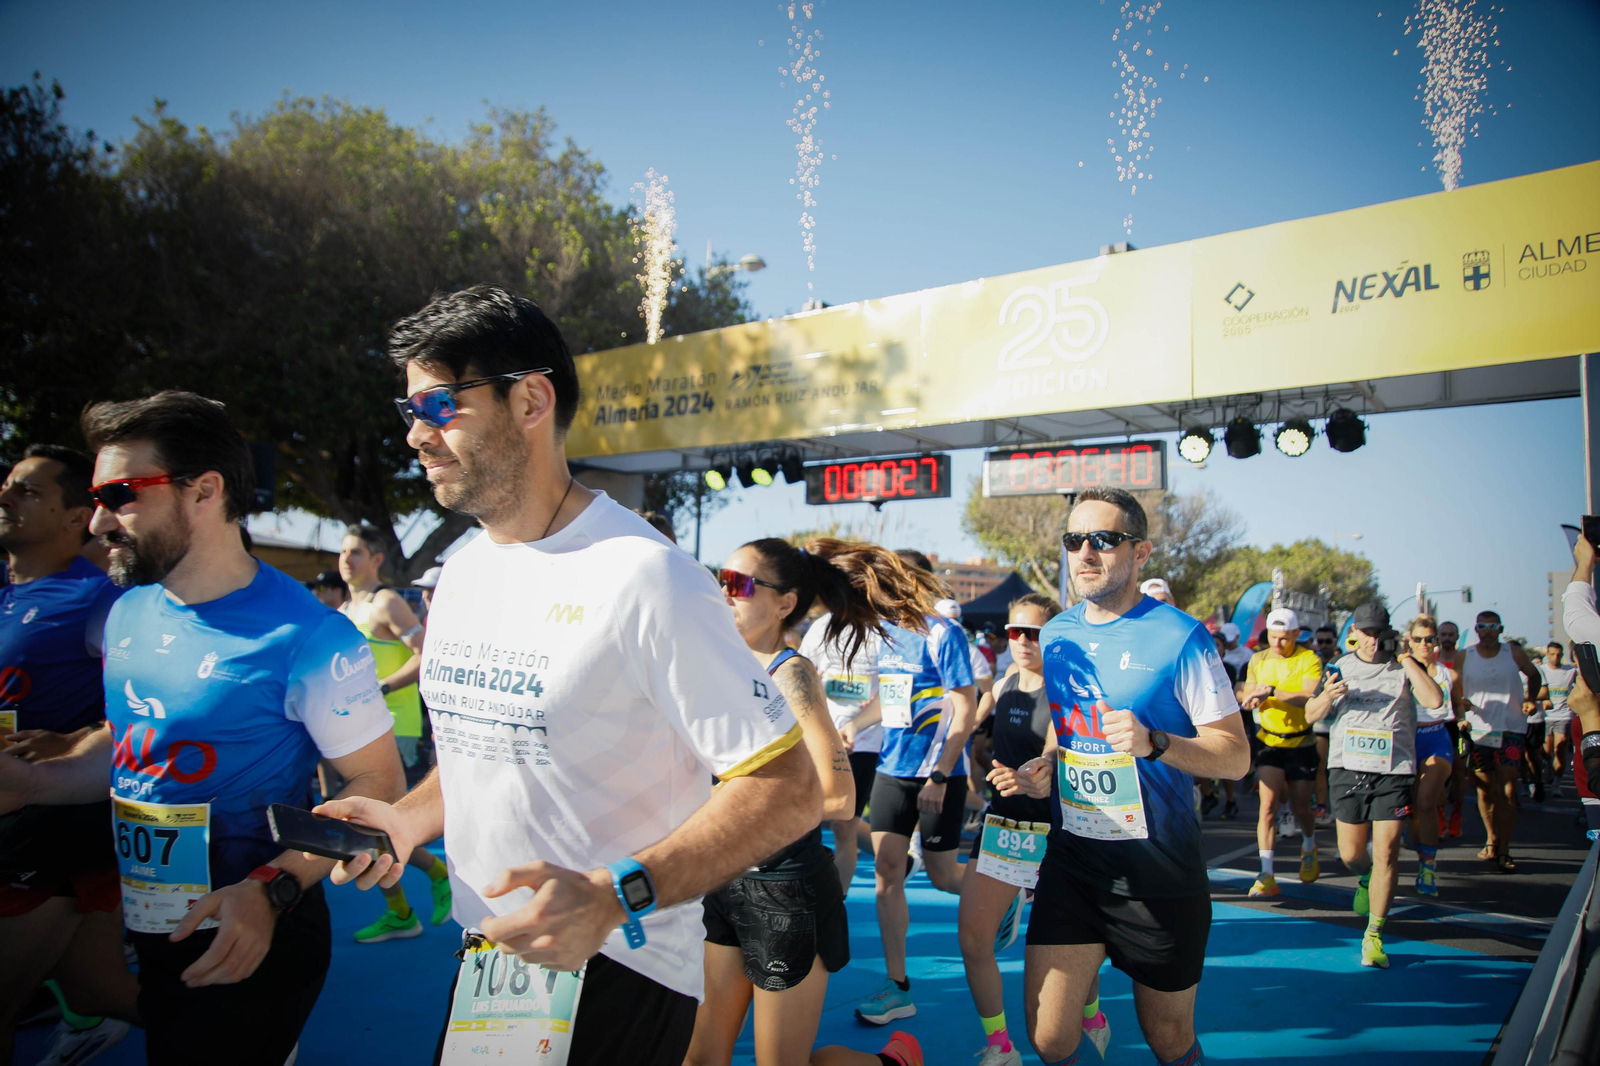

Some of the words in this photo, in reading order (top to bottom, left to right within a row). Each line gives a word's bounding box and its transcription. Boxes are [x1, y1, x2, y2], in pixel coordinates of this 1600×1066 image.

[1518, 231, 1600, 264] ALME
[1518, 259, 1587, 281] CIUDAD
[997, 272, 1110, 371] 25
[1223, 306, 1310, 327] COOPERACIÓN
[1223, 325, 1251, 337] 2005
[597, 380, 642, 400] Medio
[647, 371, 716, 395] Maratón
[776, 388, 806, 404] RUIZ
[594, 397, 660, 425] Almería
[663, 392, 715, 418] 2024
[478, 642, 549, 670] Maratón
[424, 658, 486, 689] Almería
[489, 667, 544, 698] 2024
[460, 696, 485, 711] RUIZ
[488, 701, 546, 721] ANDÚJAR
[1049, 702, 1108, 740] GAL
[106, 720, 217, 784] ALO
[1070, 740, 1107, 754] SPORT
[1349, 735, 1387, 751] 1670
[117, 776, 155, 796] SPORT
[1068, 766, 1117, 795] 960
[1073, 792, 1110, 804] MARTINEZ
[117, 821, 180, 867] 607
[997, 828, 1037, 853] 894
[129, 864, 157, 878] JAIME
[490, 998, 541, 1012] EDUARDO
